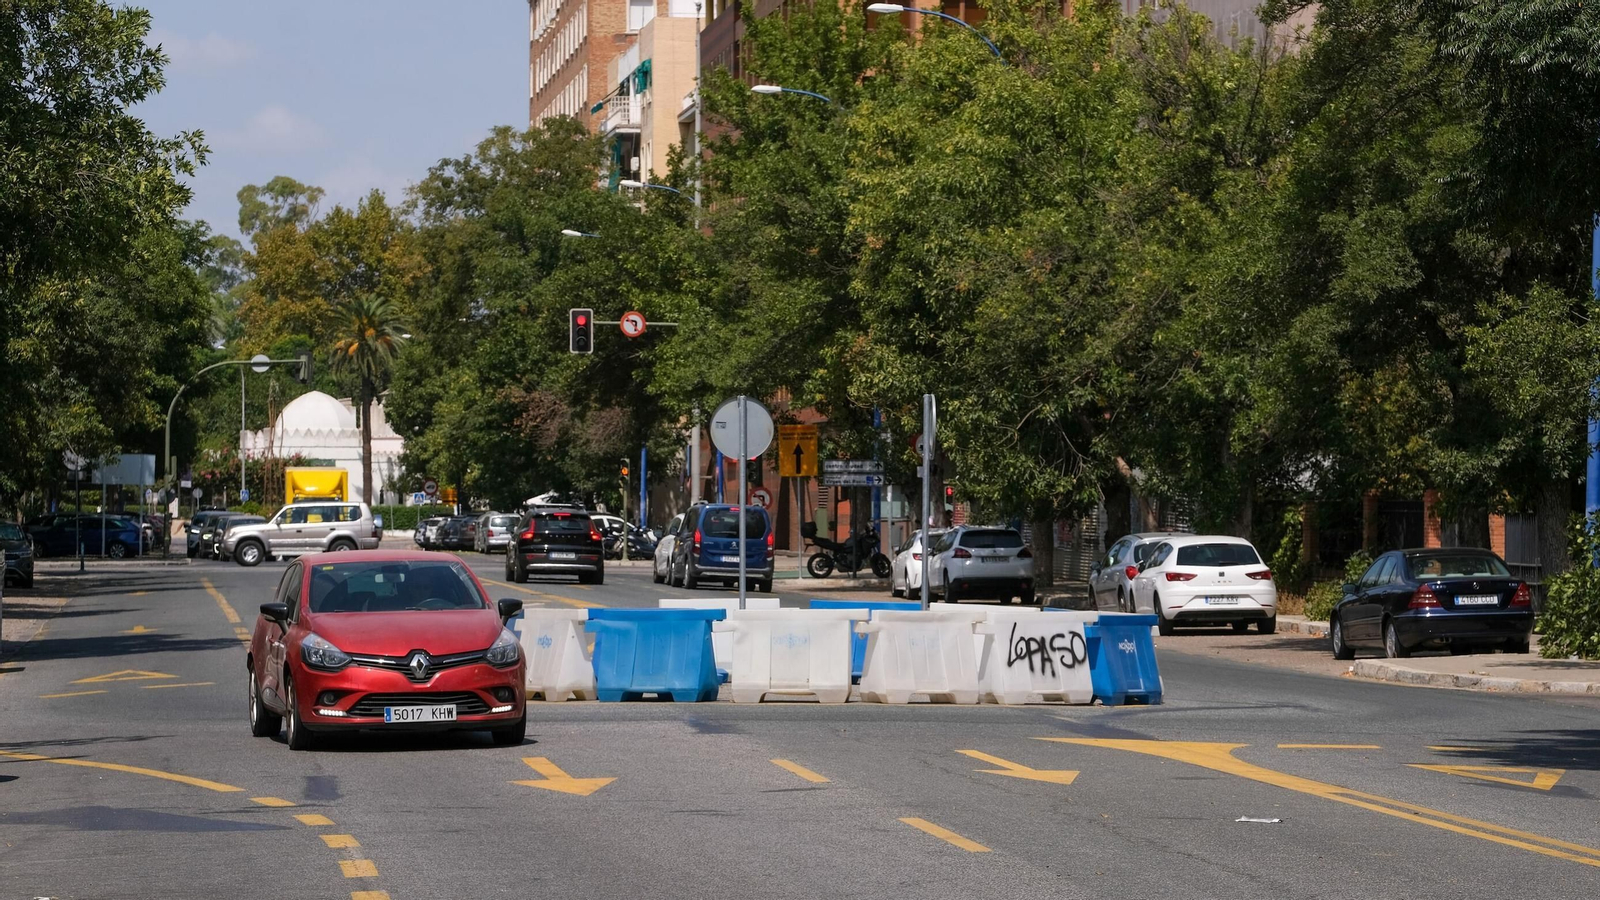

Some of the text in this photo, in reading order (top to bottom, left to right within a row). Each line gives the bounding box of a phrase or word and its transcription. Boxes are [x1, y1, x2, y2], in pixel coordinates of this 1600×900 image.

[1460, 595, 1479, 604] 4160
[394, 707, 454, 721] 5017 KHW
